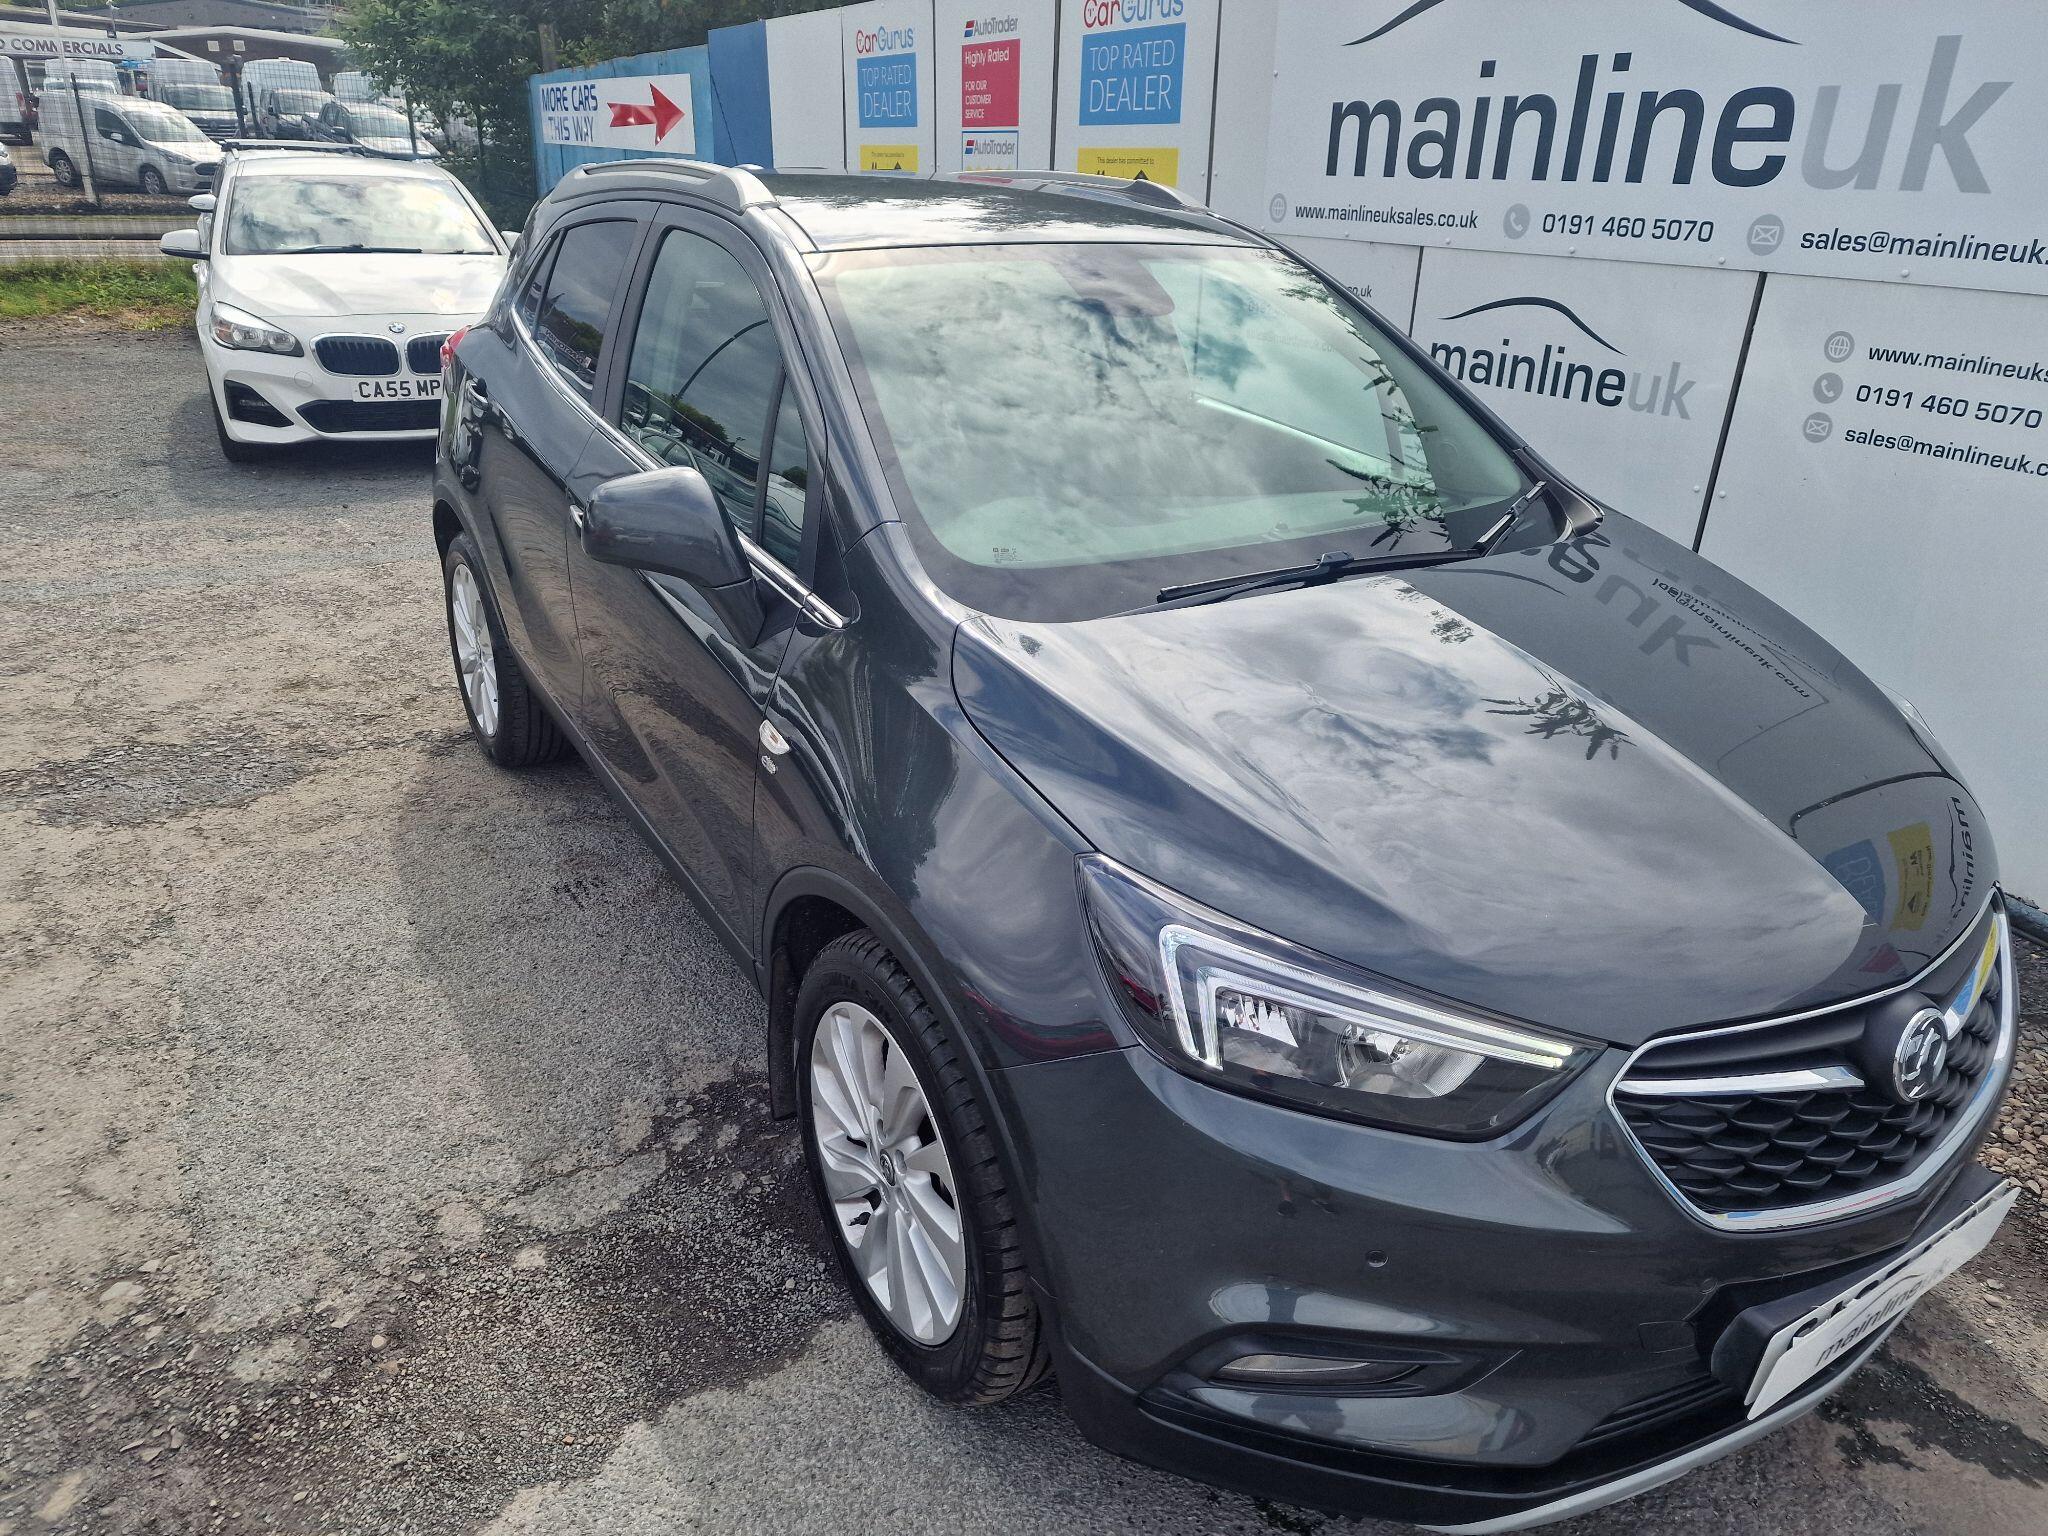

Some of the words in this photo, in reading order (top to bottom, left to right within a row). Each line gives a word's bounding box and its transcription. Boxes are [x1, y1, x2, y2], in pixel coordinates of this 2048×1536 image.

[973, 16, 1019, 36] AutoTrader
[1083, 0, 1184, 28] CarGurus
[11, 38, 124, 56] COMMERCIALS
[855, 25, 914, 54] CarGurus
[965, 51, 986, 68] Highly
[987, 47, 1010, 62] Rated
[1090, 46, 1118, 71] TOP
[1123, 39, 1175, 69] RATED
[861, 67, 879, 87] TOP
[881, 64, 912, 86] RATED
[965, 81, 974, 91] FOR
[976, 79, 988, 91] OUR
[541, 86, 569, 112] MORE
[571, 84, 598, 112] CARS
[863, 90, 912, 118] DEALER
[965, 93, 992, 105] CUSTOMER
[1089, 74, 1172, 113] DEALER
[965, 108, 985, 119] SERVICE
[548, 116, 570, 141] THIS
[572, 115, 593, 142] WAY
[975, 139, 1016, 155] AutoTrader
[1295, 202, 1478, 230] www.mainlineuksales.co.uk
[1543, 212, 1595, 236] 0191
[1601, 215, 1645, 239] 460
[1651, 218, 1715, 243] 5070
[358, 380, 411, 398] CA55
[416, 379, 441, 396] MP
[1856, 384, 1913, 409] 0191
[1920, 394, 1969, 417] 460
[1974, 401, 2043, 429] 5070
